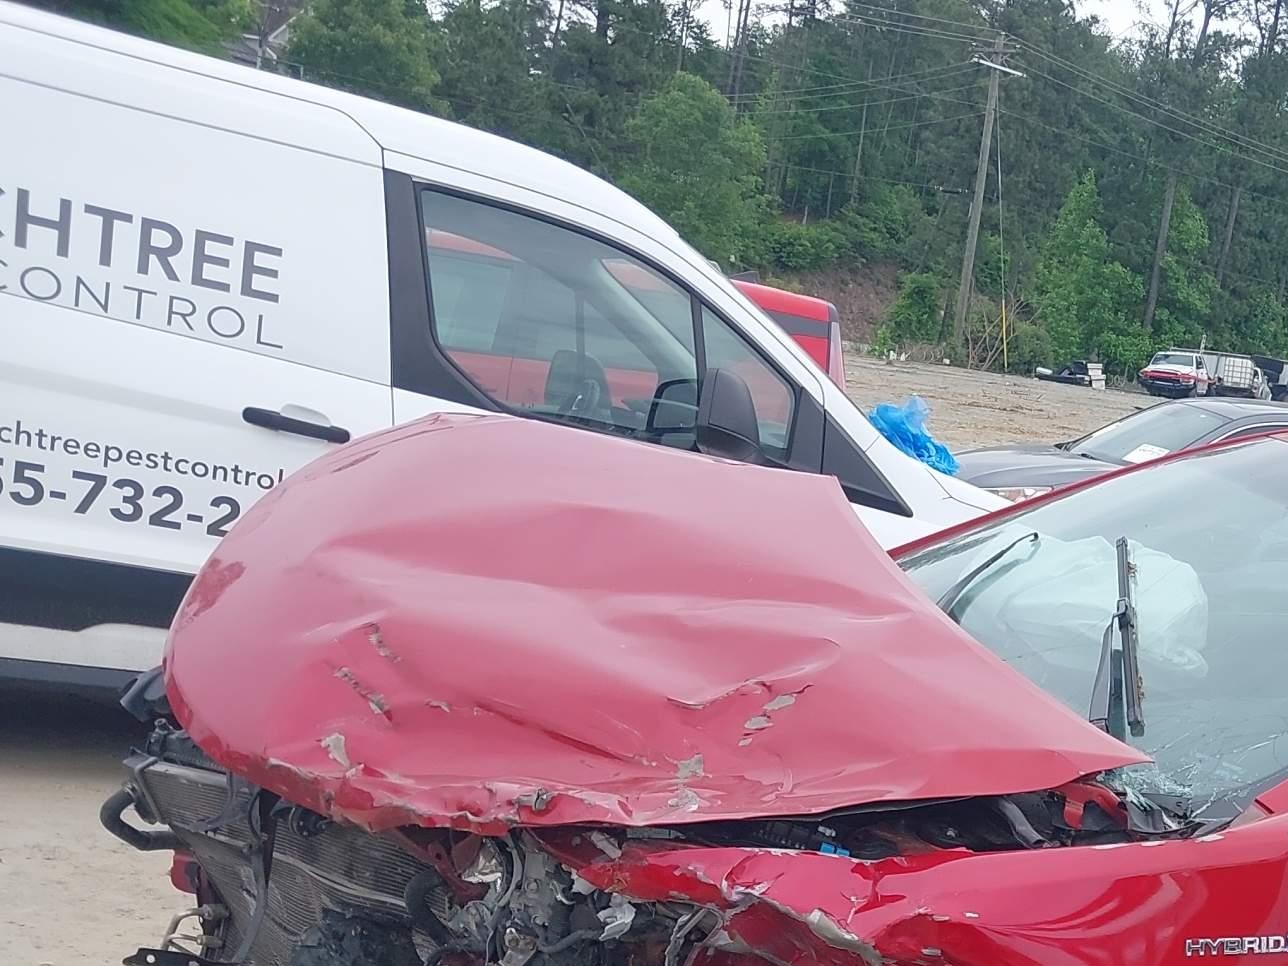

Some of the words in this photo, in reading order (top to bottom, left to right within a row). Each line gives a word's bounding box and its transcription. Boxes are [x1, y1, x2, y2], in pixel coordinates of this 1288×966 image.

[0, 187, 283, 303] HTREE
[0, 457, 240, 538] 5-732-2
[1186, 936, 1286, 957] HYBRID
